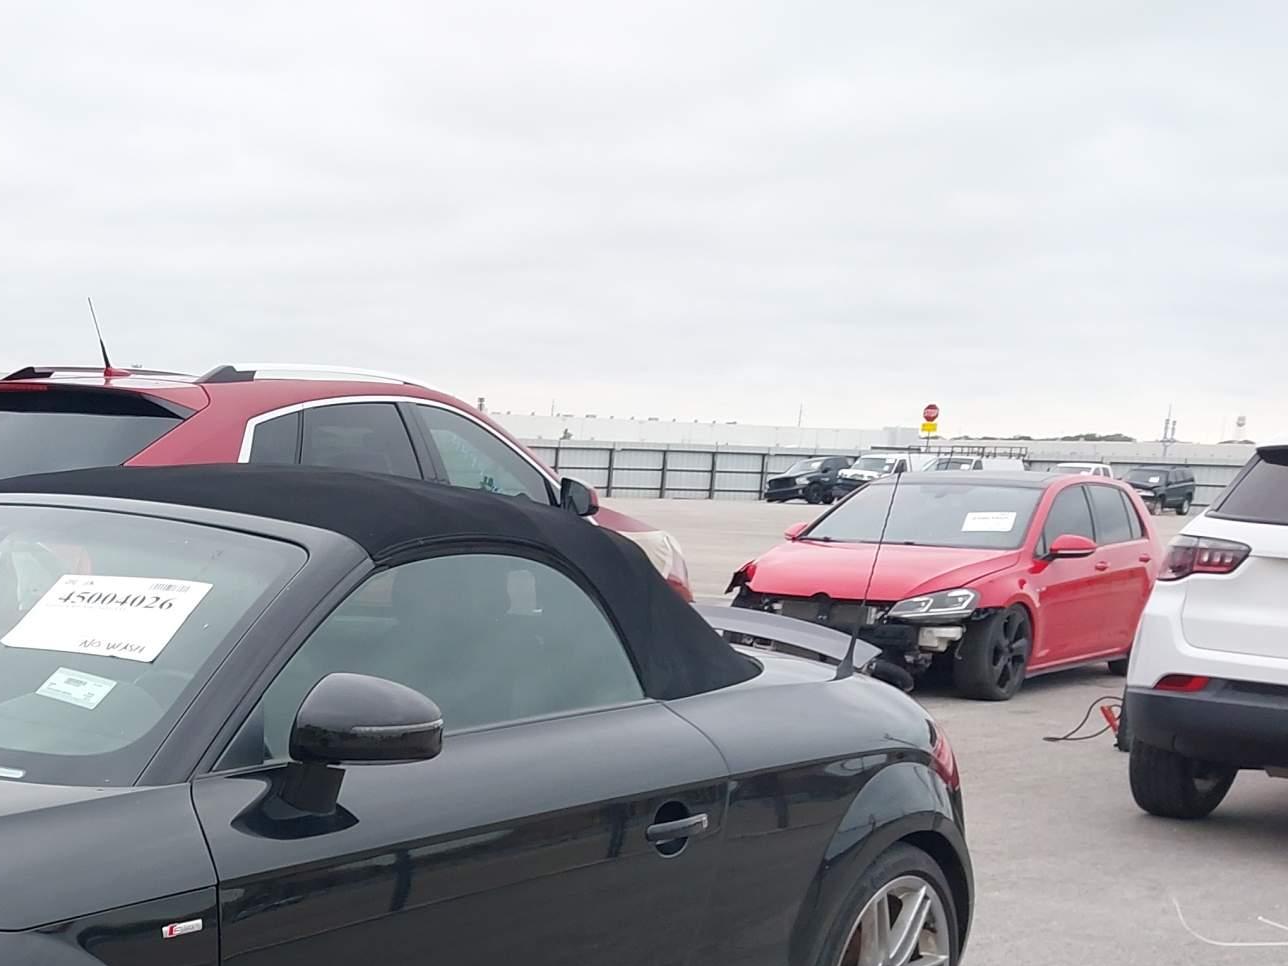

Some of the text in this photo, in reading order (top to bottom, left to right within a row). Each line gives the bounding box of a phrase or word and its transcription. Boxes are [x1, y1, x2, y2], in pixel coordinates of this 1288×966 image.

[58, 591, 174, 610] 45004026
[79, 639, 146, 654] NO WASH
